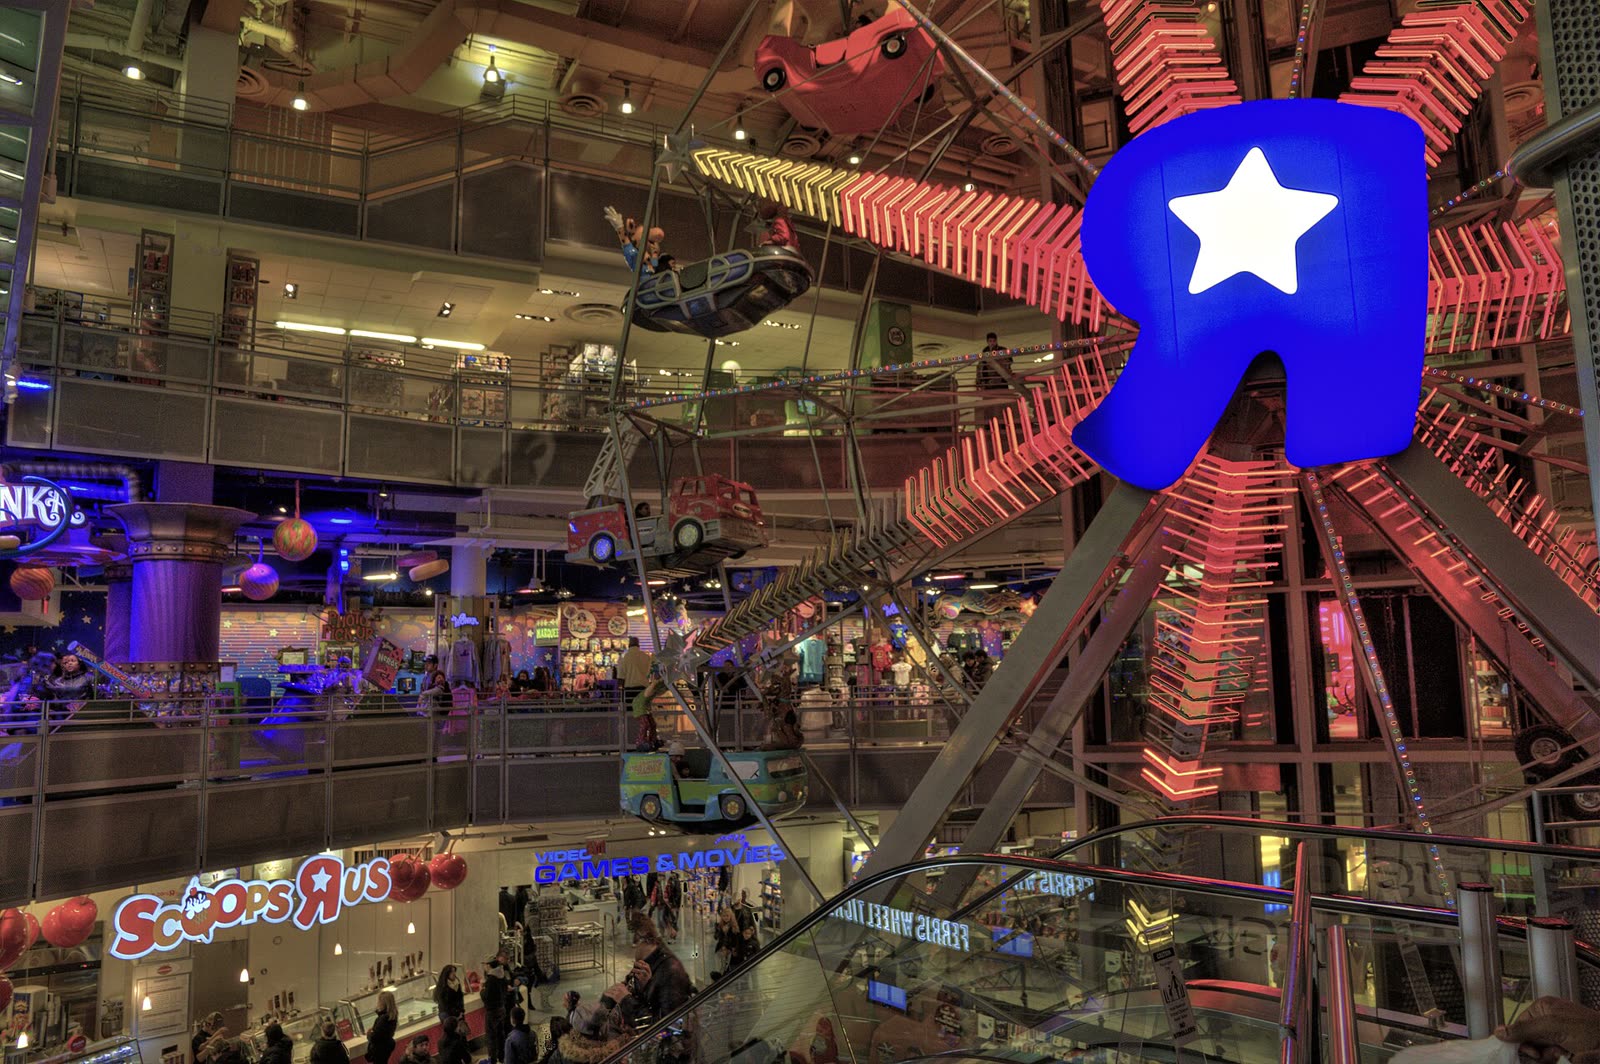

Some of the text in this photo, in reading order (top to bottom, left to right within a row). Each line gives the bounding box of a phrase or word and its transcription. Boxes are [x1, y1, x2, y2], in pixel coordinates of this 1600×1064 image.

[534, 856, 650, 884] GAMES
[655, 853, 677, 872] &
[110, 876, 294, 960] SCOOPS
